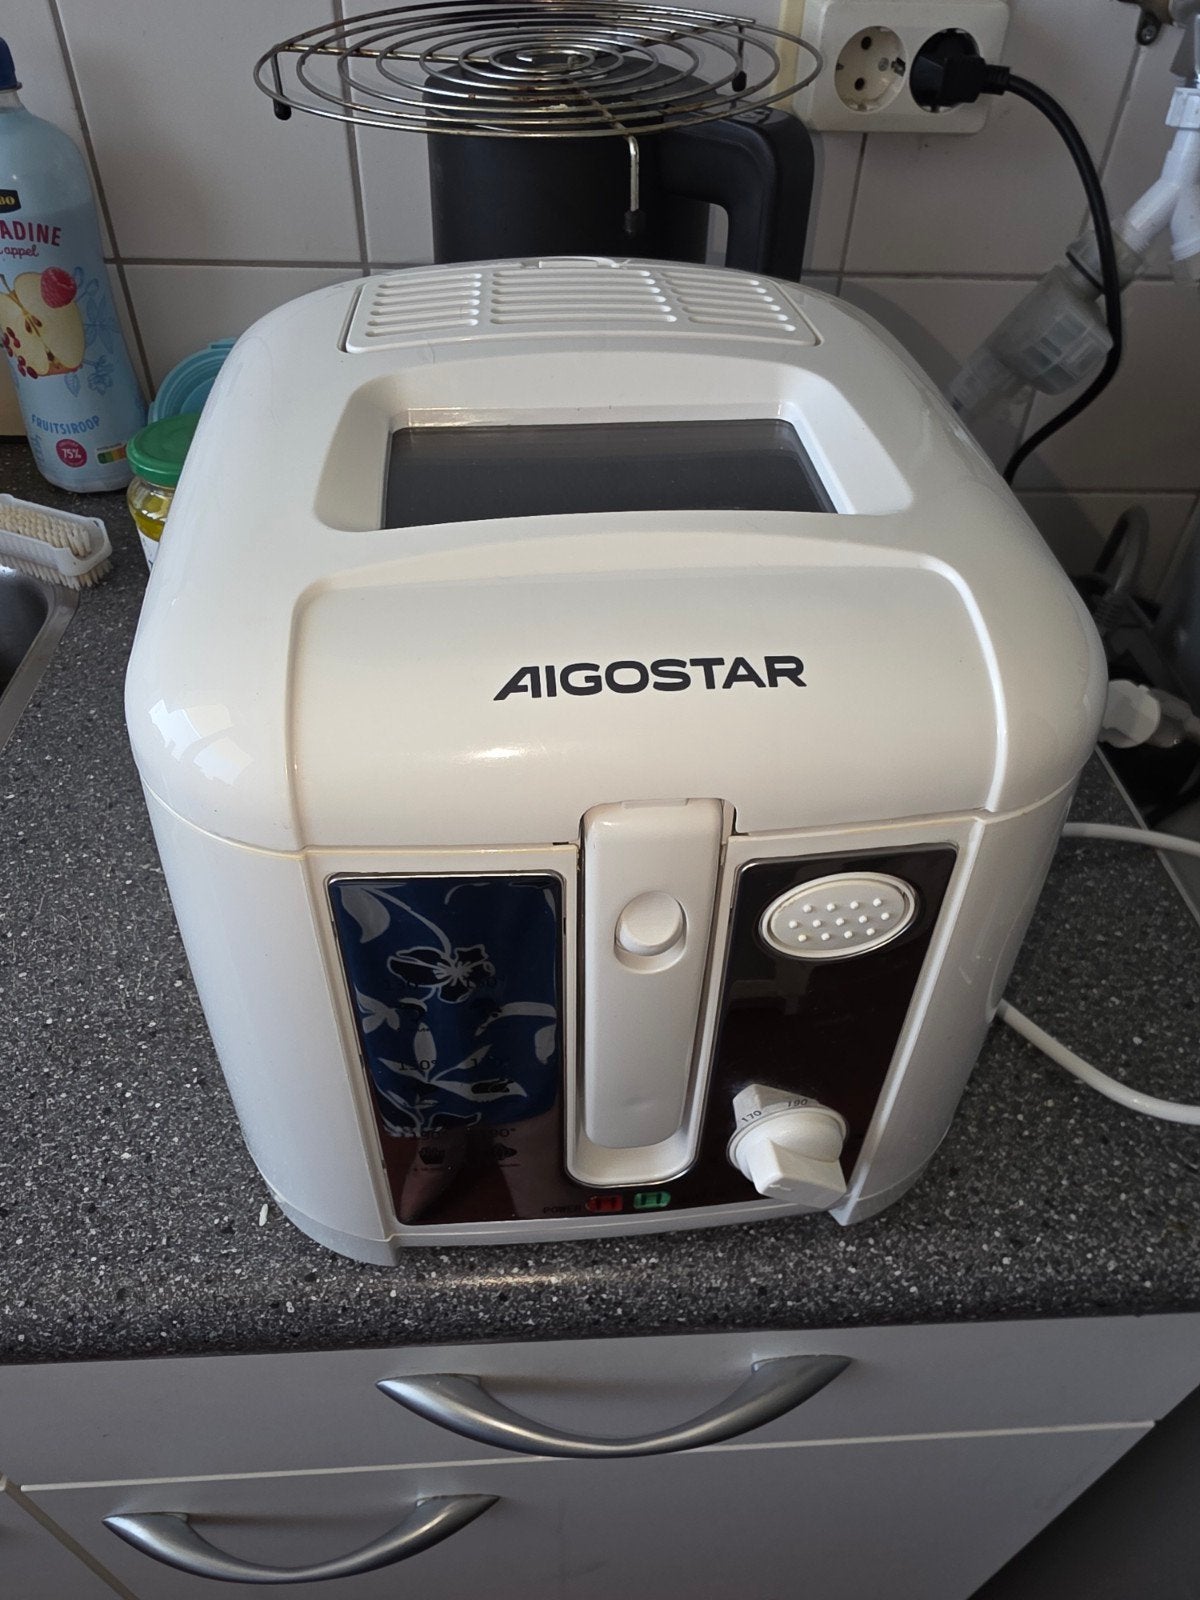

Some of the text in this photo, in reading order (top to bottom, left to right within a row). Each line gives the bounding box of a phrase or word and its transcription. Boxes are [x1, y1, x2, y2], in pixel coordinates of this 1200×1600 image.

[4, 244, 40, 259] appel
[31, 413, 100, 435] FRUITSIROOP
[61, 448, 82, 459] 75%
[493, 655, 807, 701] AIGOSTAR
[787, 1098, 809, 1108] 190
[742, 1110, 762, 1123] 170
